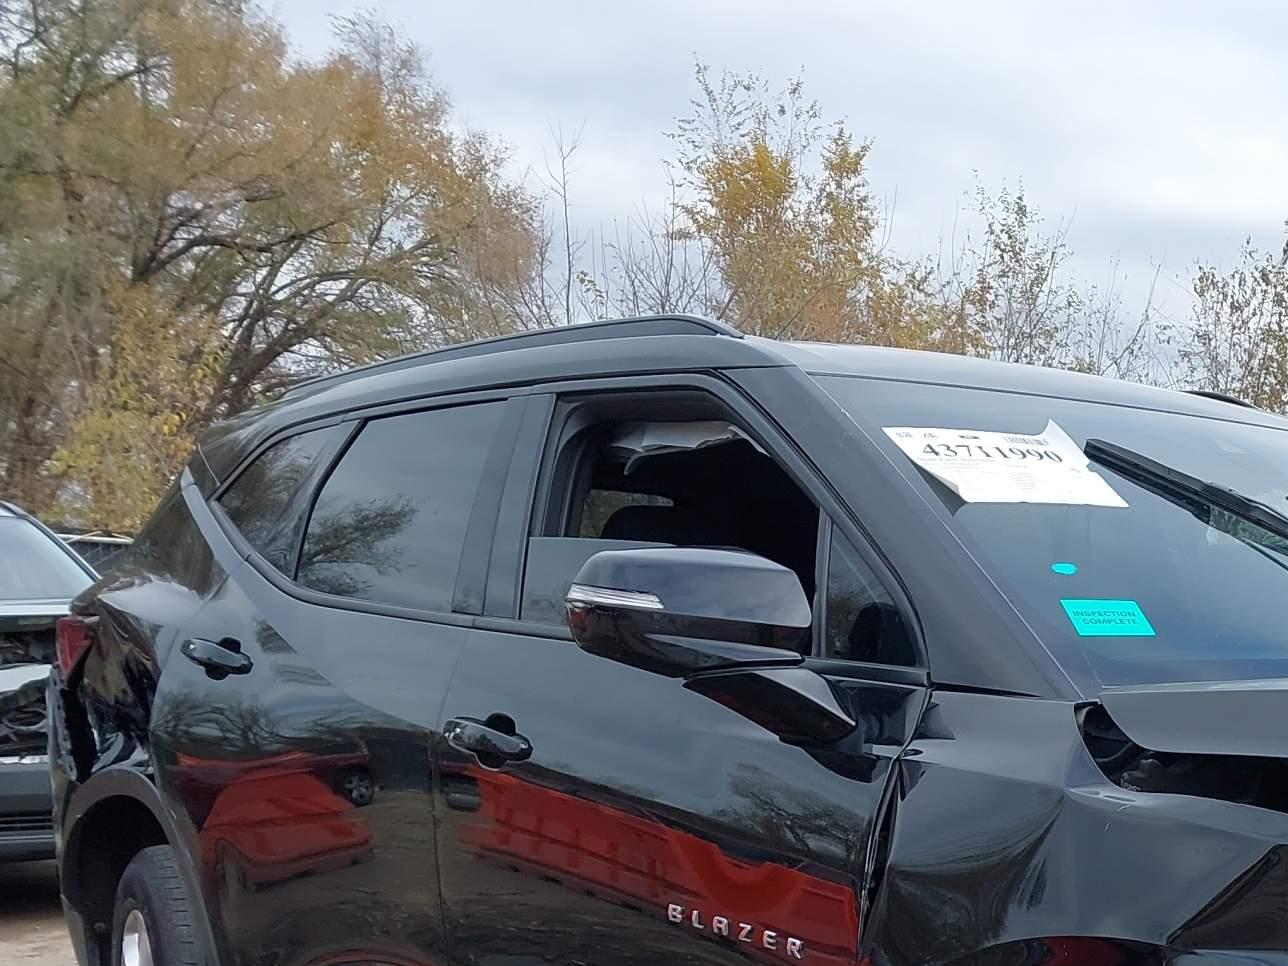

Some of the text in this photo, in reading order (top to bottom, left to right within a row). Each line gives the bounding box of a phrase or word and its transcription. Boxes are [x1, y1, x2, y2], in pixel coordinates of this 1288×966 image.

[922, 443, 1064, 463] 43711990
[1072, 610, 1137, 618] INSPECTION
[1081, 617, 1139, 625] COMPLETE
[667, 903, 806, 960] BLAZER
